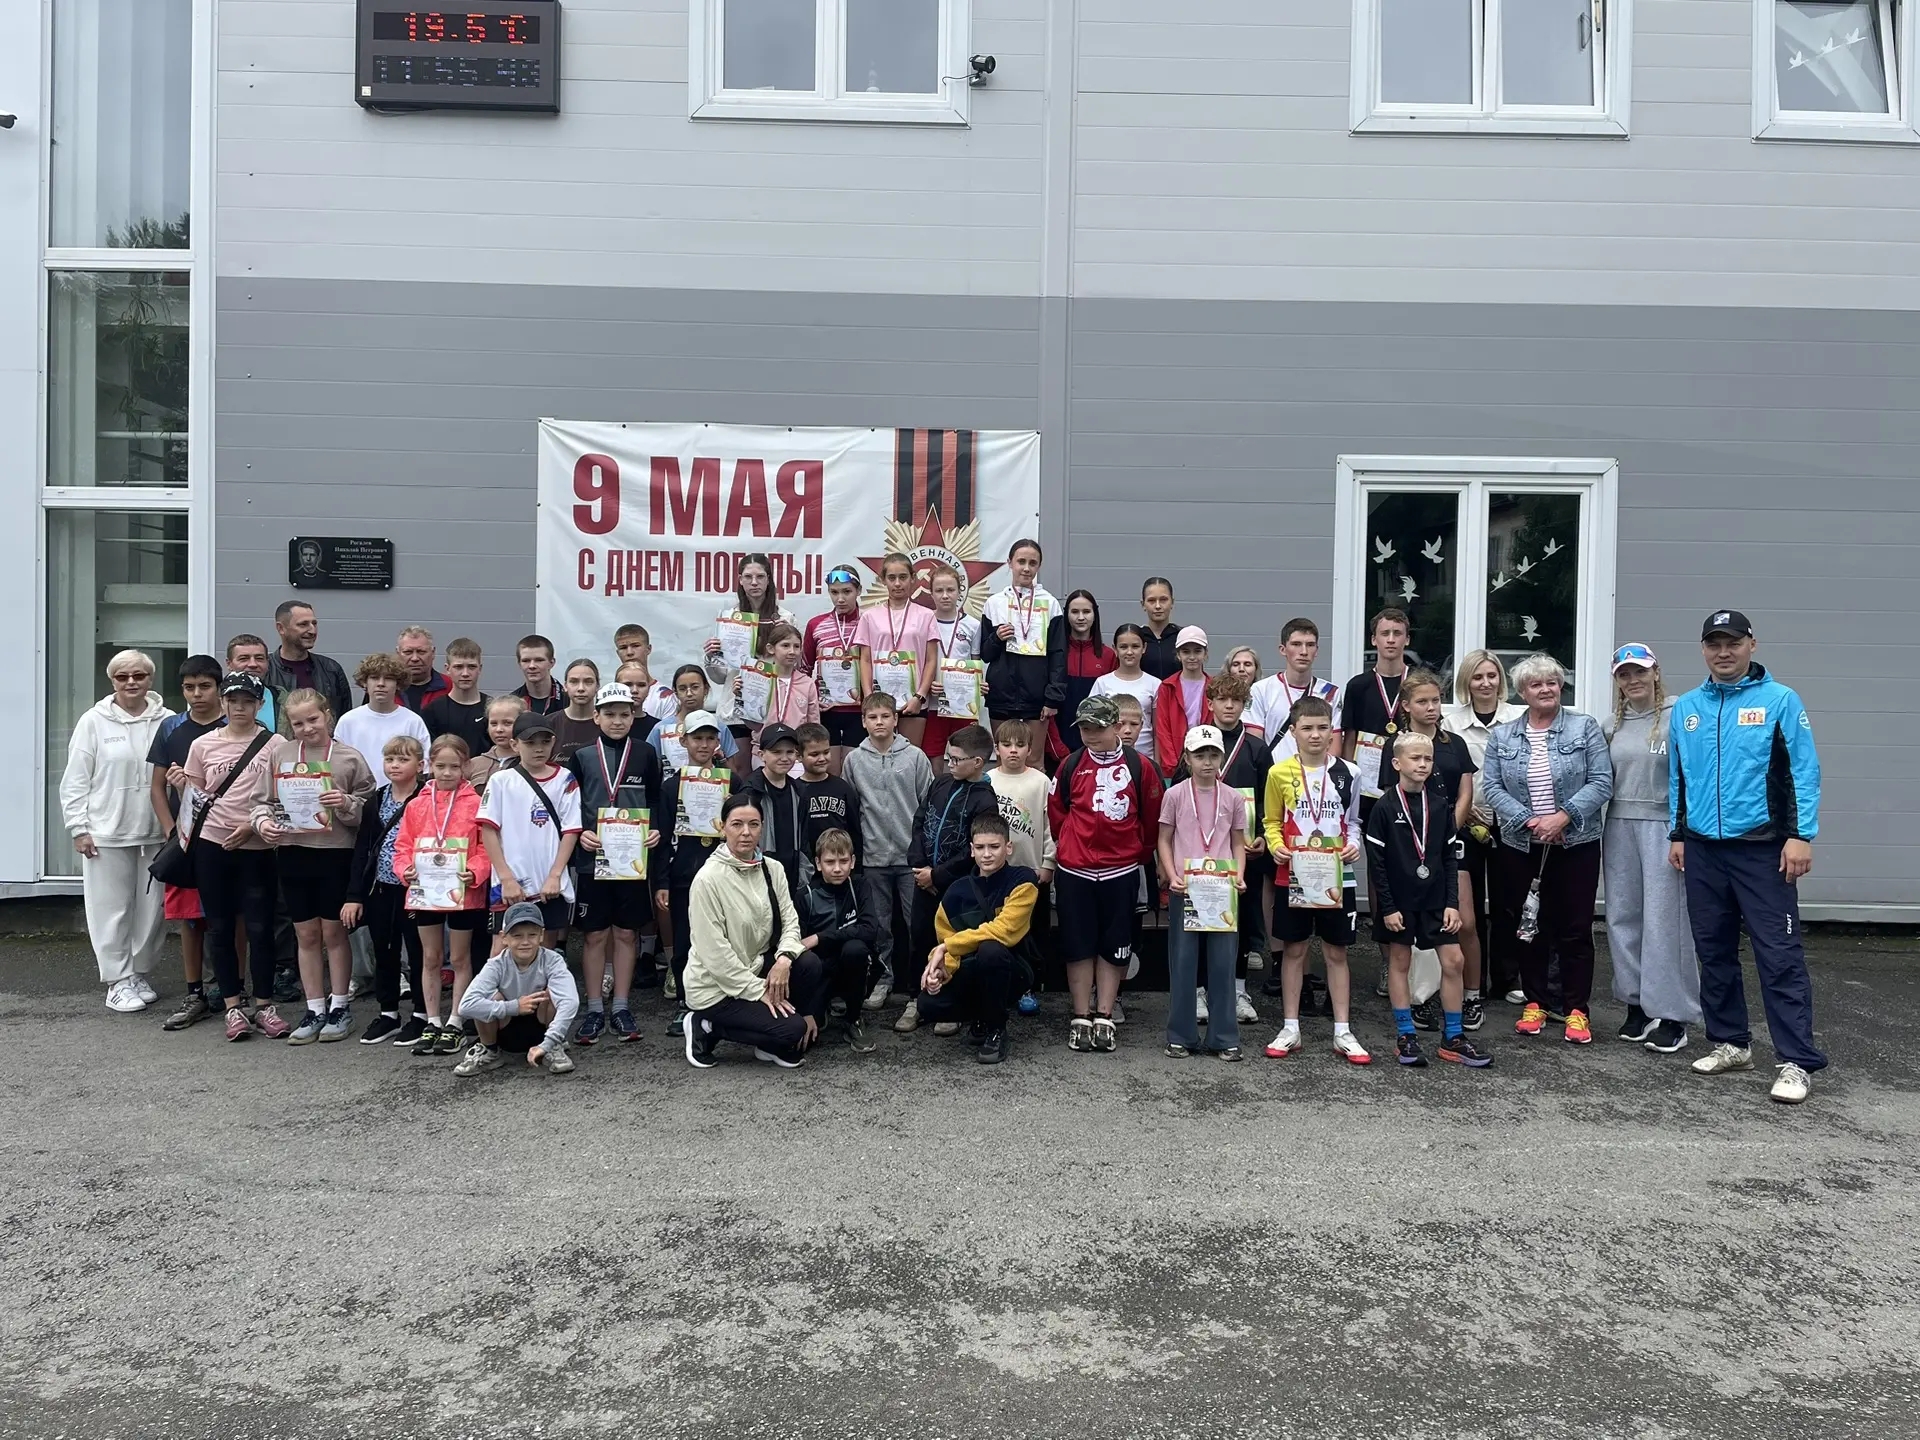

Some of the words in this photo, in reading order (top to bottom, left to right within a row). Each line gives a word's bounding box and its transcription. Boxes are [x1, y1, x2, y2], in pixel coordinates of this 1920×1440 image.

[573, 455, 620, 535] 9
[650, 457, 823, 538] МАЯ
[578, 549, 595, 590] С
[605, 551, 684, 597] ДНЕМ
[602, 689, 627, 699] BRAVE
[1202, 728, 1212, 738] LA
[1649, 740, 1667, 755] LA
[282, 780, 323, 788] ГРАМОТА
[626, 775, 642, 783] FILA
[686, 783, 722, 793] ГРАМОТА
[604, 825, 641, 833] ГРАМОТА
[1191, 877, 1230, 885] ГРАМОТА
[1347, 911, 1357, 931] 7
